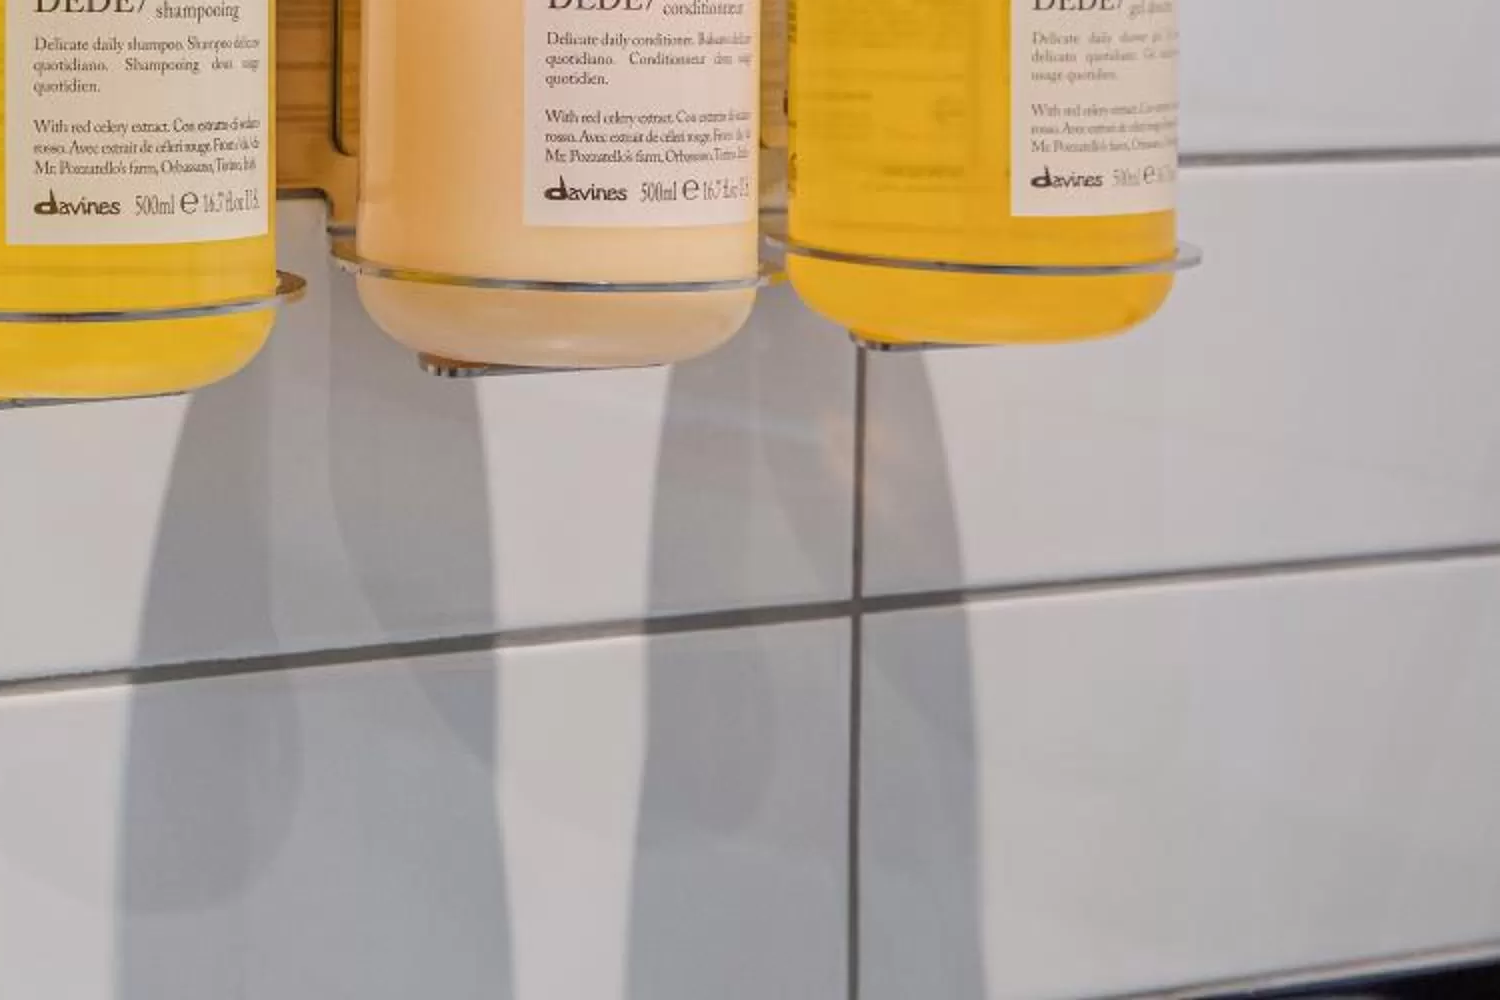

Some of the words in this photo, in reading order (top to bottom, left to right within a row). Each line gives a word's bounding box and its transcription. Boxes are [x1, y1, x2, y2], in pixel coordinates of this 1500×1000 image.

[156, 1, 240, 22] shampooing
[35, 37, 88, 51] Delicate
[93, 36, 123, 55] daily
[547, 32, 599, 46] Delicate
[600, 32, 628, 49] daily
[33, 79, 100, 95] quotidien.
[545, 72, 609, 88] quotidien.
[545, 110, 579, 124] With
[581, 109, 601, 124] red
[34, 119, 68, 134] With
[71, 119, 91, 133] red
[93, 119, 127, 137] celery
[140, 141, 153, 154] de
[1031, 163, 1103, 189] davines
[544, 175, 628, 201] davines
[34, 189, 120, 215] davines
[135, 195, 175, 216] 500ml
